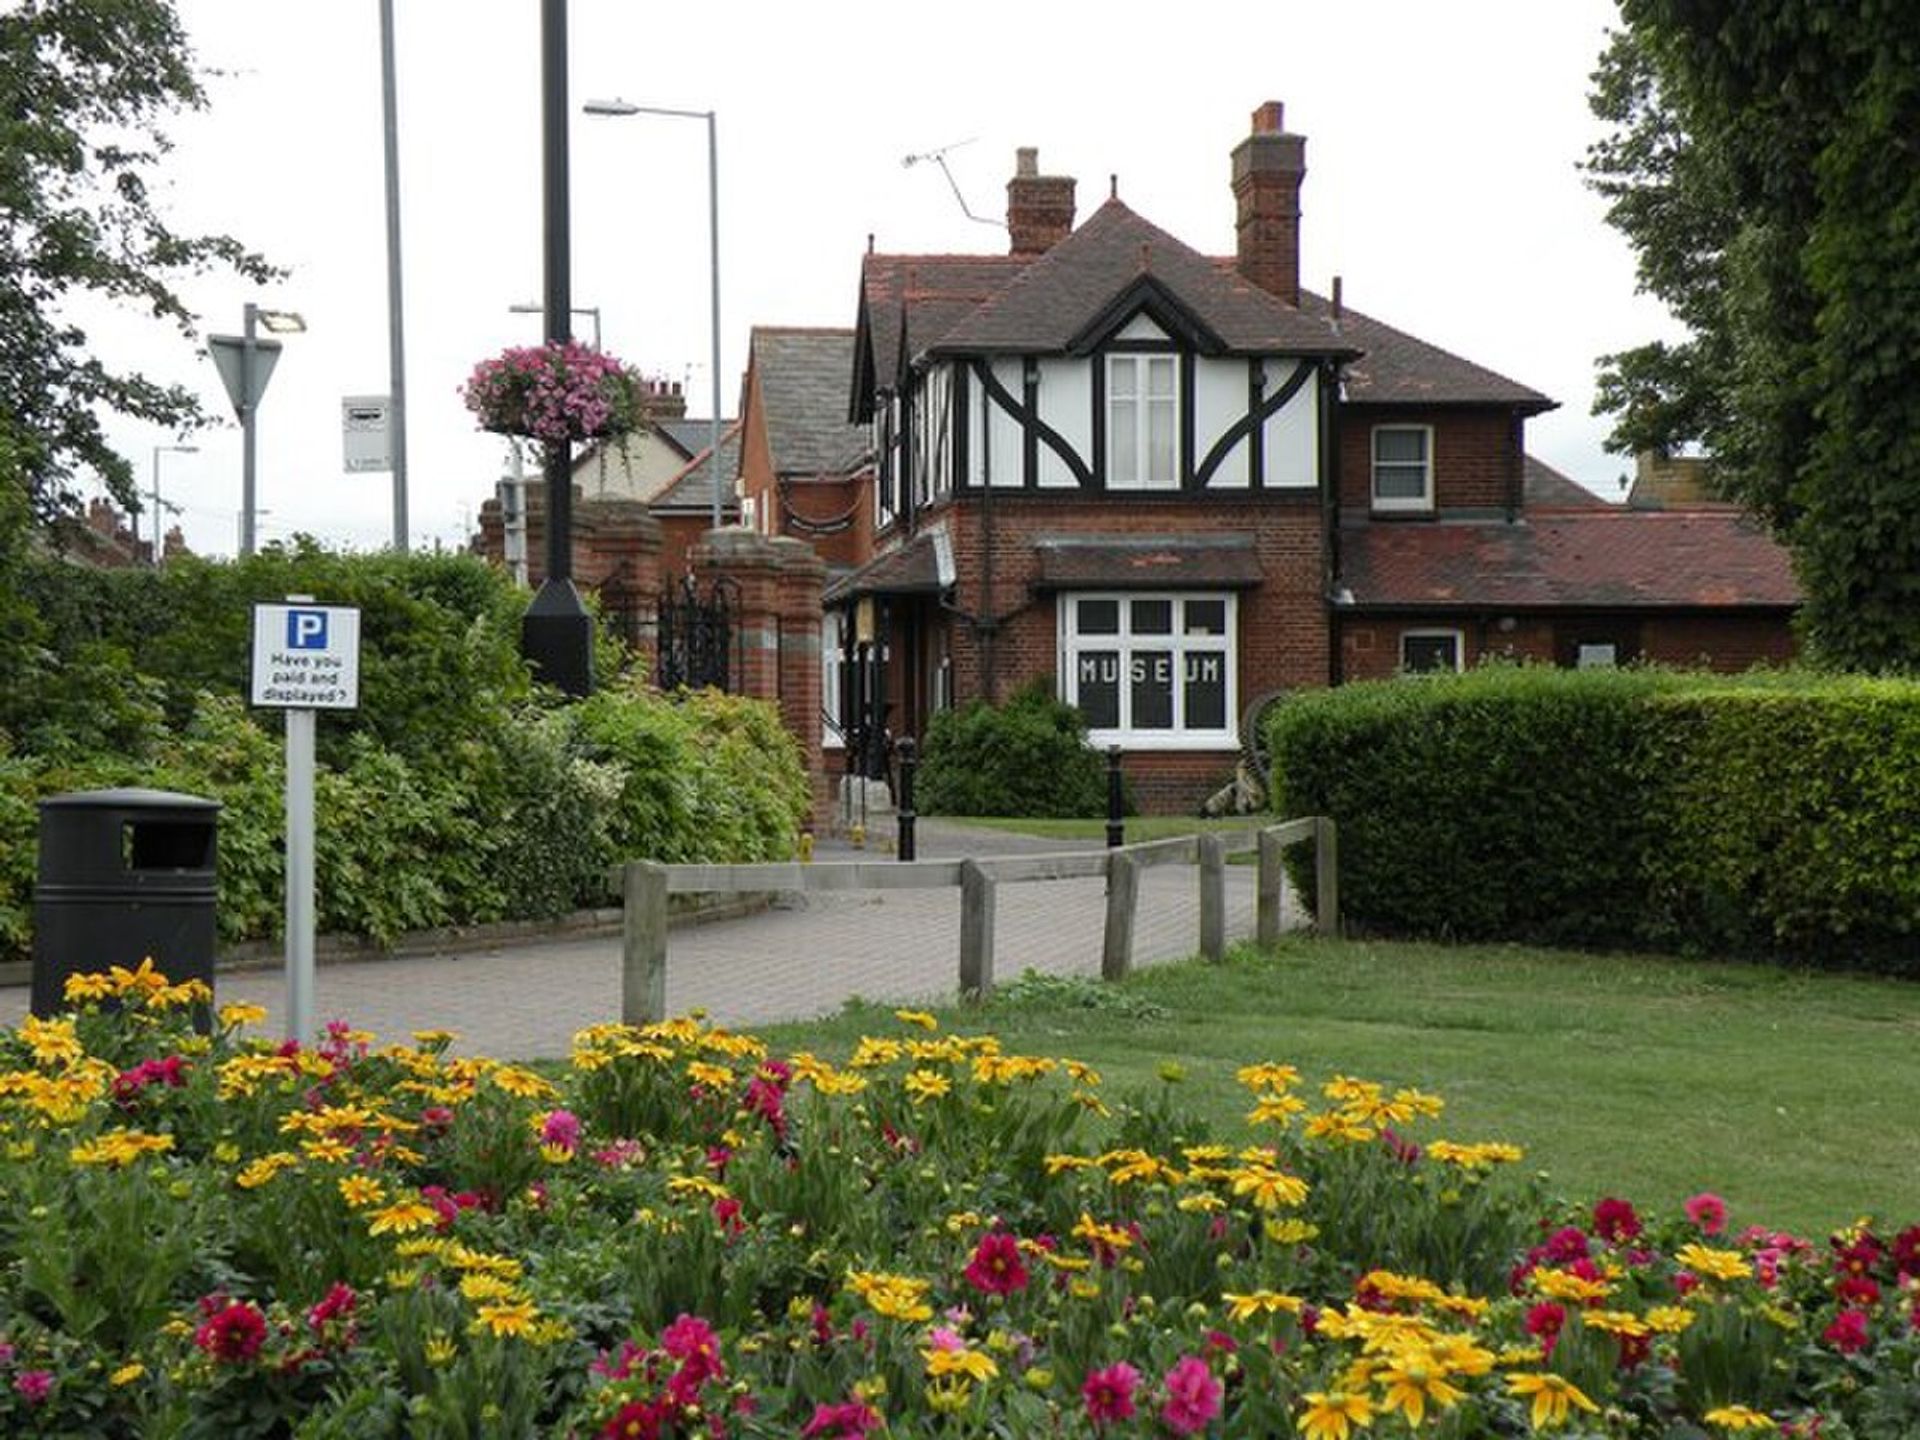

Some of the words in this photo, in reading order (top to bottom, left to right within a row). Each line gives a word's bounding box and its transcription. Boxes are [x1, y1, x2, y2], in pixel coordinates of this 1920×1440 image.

[297, 614, 322, 647] P
[271, 653, 309, 667] Have
[313, 656, 342, 669] you
[272, 672, 306, 685] paid
[312, 672, 338, 686] and
[1080, 659, 1219, 683] MUSEUM
[263, 688, 347, 703] displayed?
